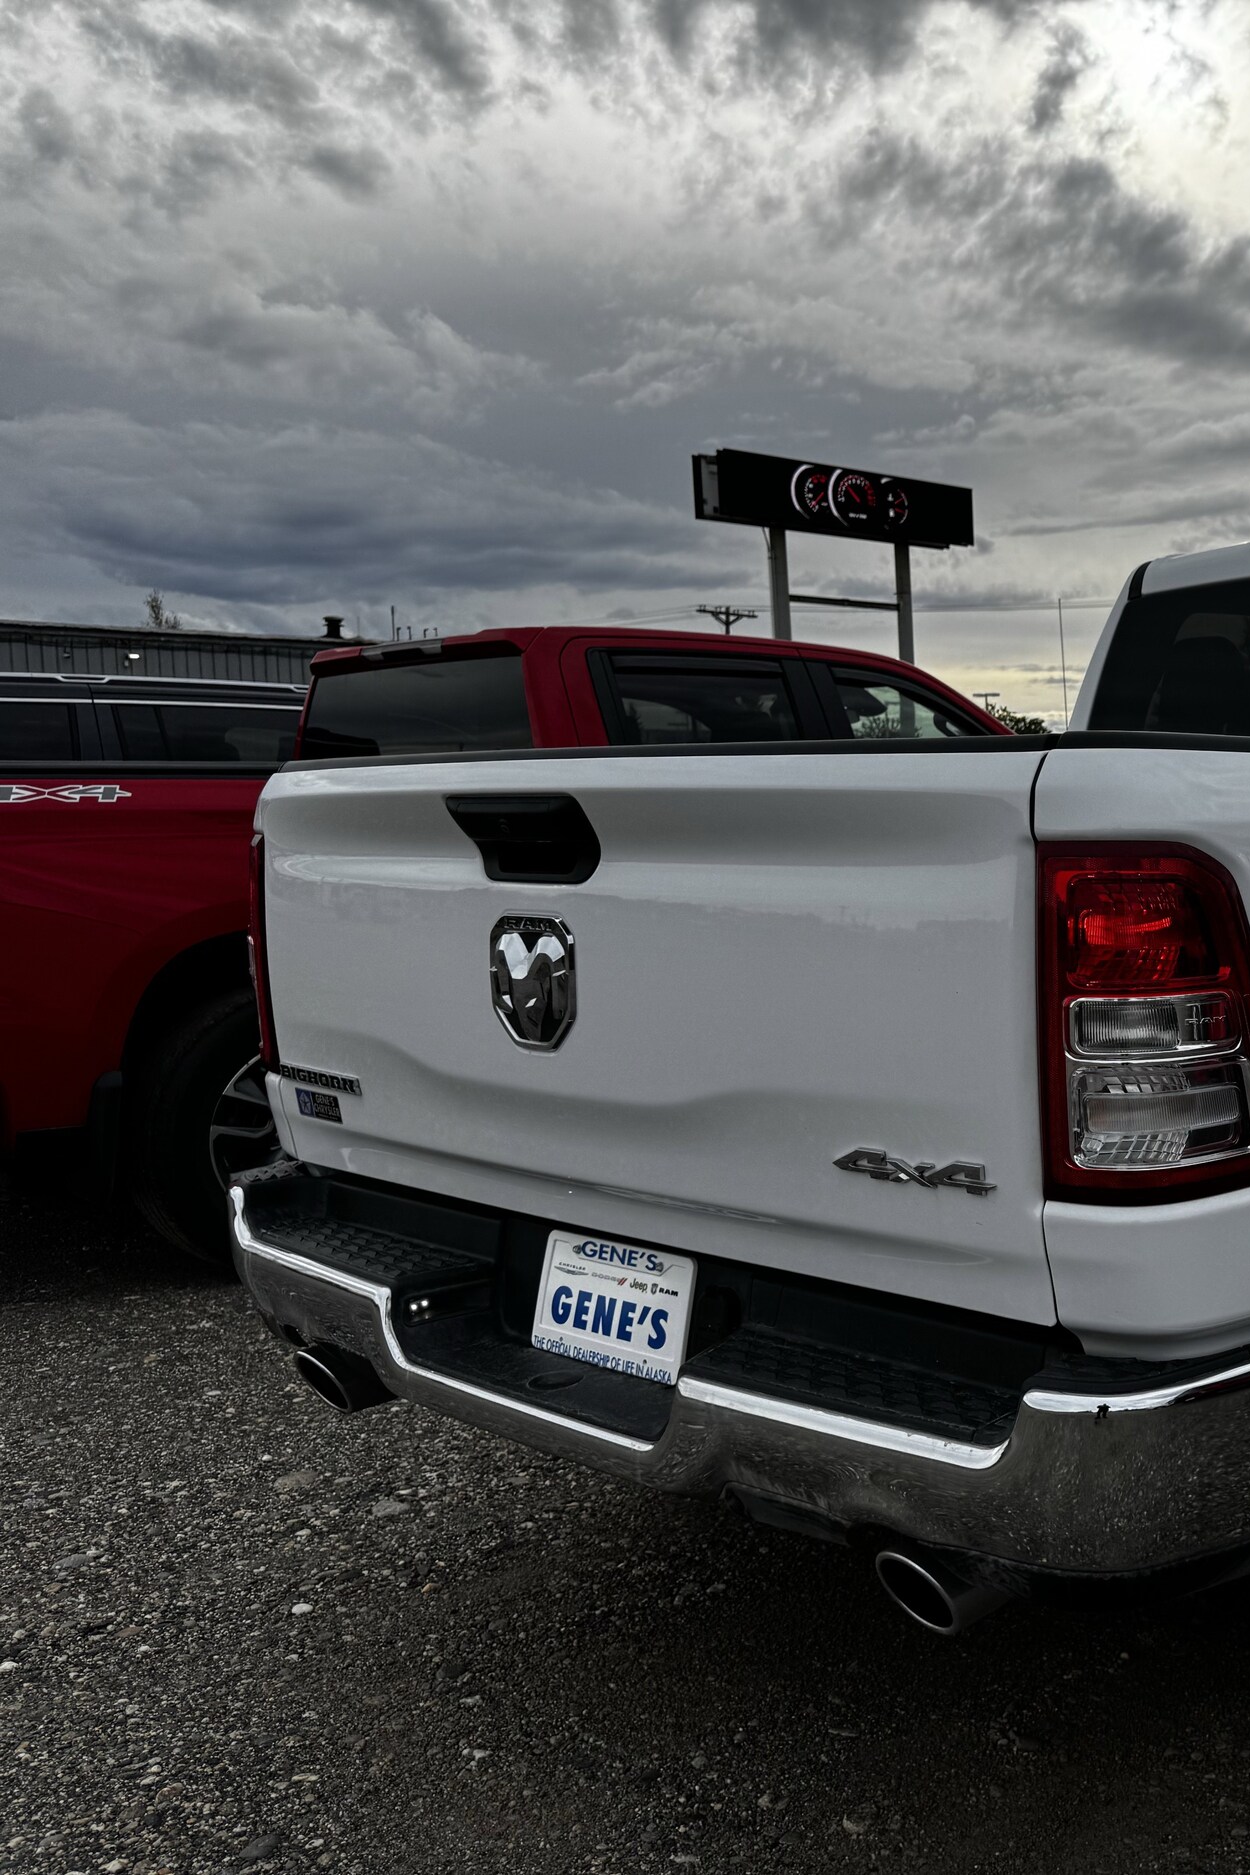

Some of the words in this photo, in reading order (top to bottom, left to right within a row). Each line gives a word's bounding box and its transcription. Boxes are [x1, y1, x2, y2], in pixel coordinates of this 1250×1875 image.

[504, 918, 553, 931] RAM
[581, 1241, 657, 1271] GENE'S
[630, 1278, 647, 1293] Jeep
[658, 1287, 679, 1297] RAM
[551, 1285, 669, 1350] GENE'S
[534, 1335, 545, 1347] THE
[546, 1339, 572, 1357] OFFICIAL
[611, 1357, 621, 1370] OF
[622, 1359, 635, 1373] LIFE
[635, 1362, 644, 1376] IN
[645, 1366, 672, 1384] ALASKA
